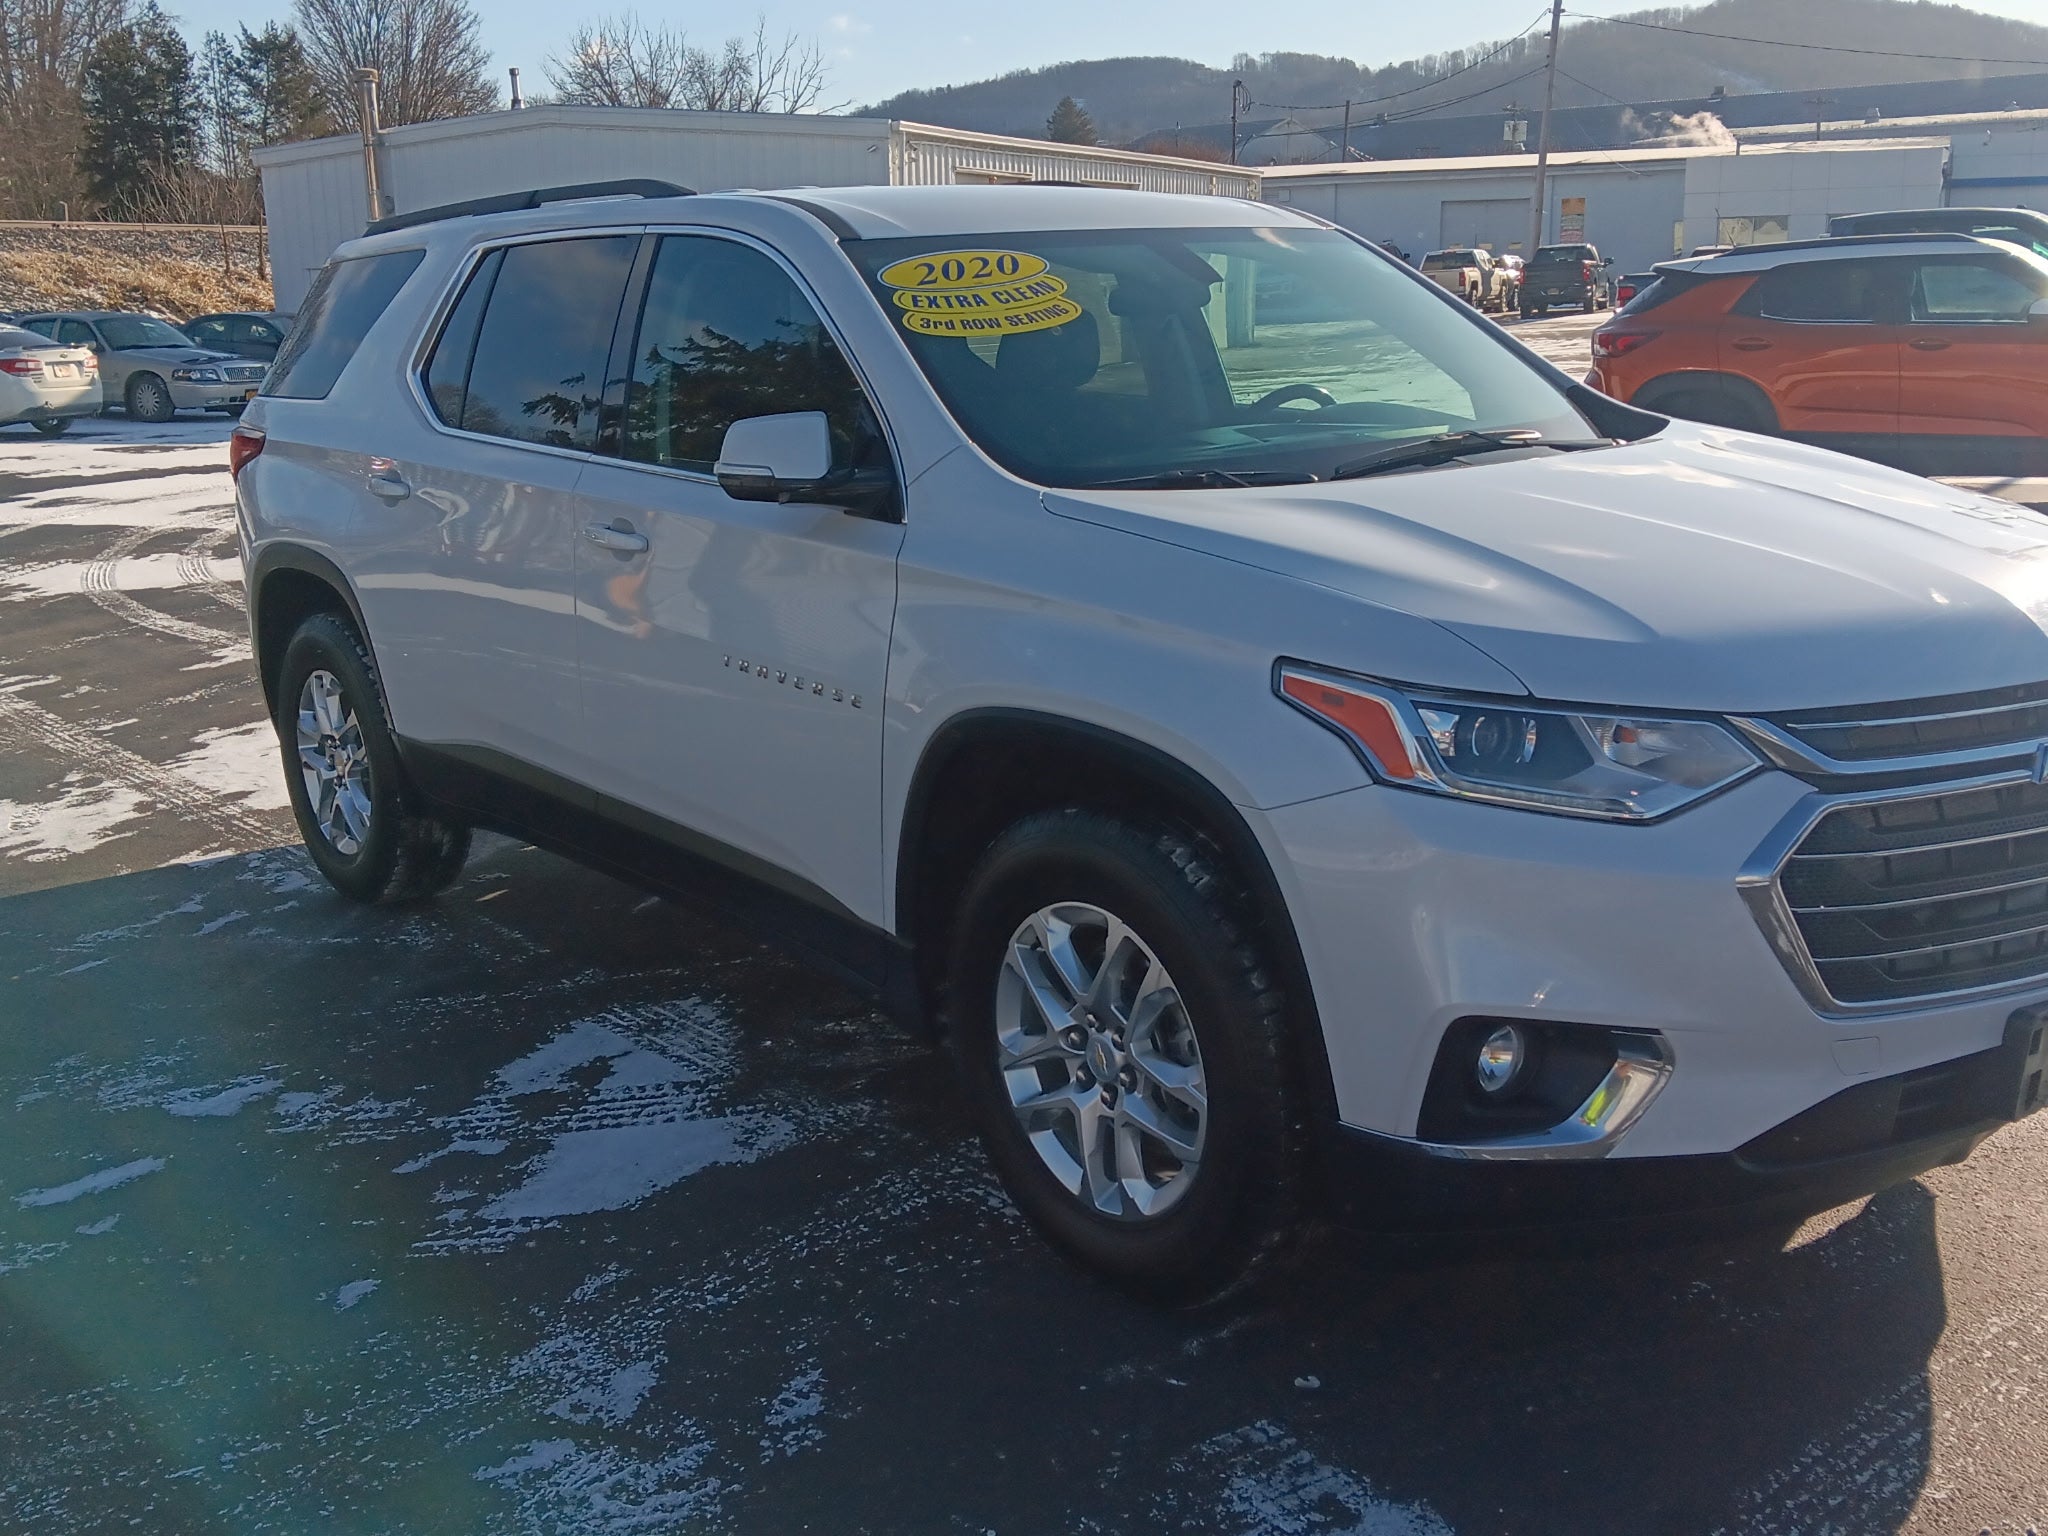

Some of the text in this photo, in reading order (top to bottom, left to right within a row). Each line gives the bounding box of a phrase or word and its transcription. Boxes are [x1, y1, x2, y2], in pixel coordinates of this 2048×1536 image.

[913, 254, 1020, 286] 2020
[911, 279, 1058, 309] EXTRA CLEAN
[919, 304, 1070, 330] 3rd ROW SEATING
[723, 654, 863, 709] TRAVERSE
